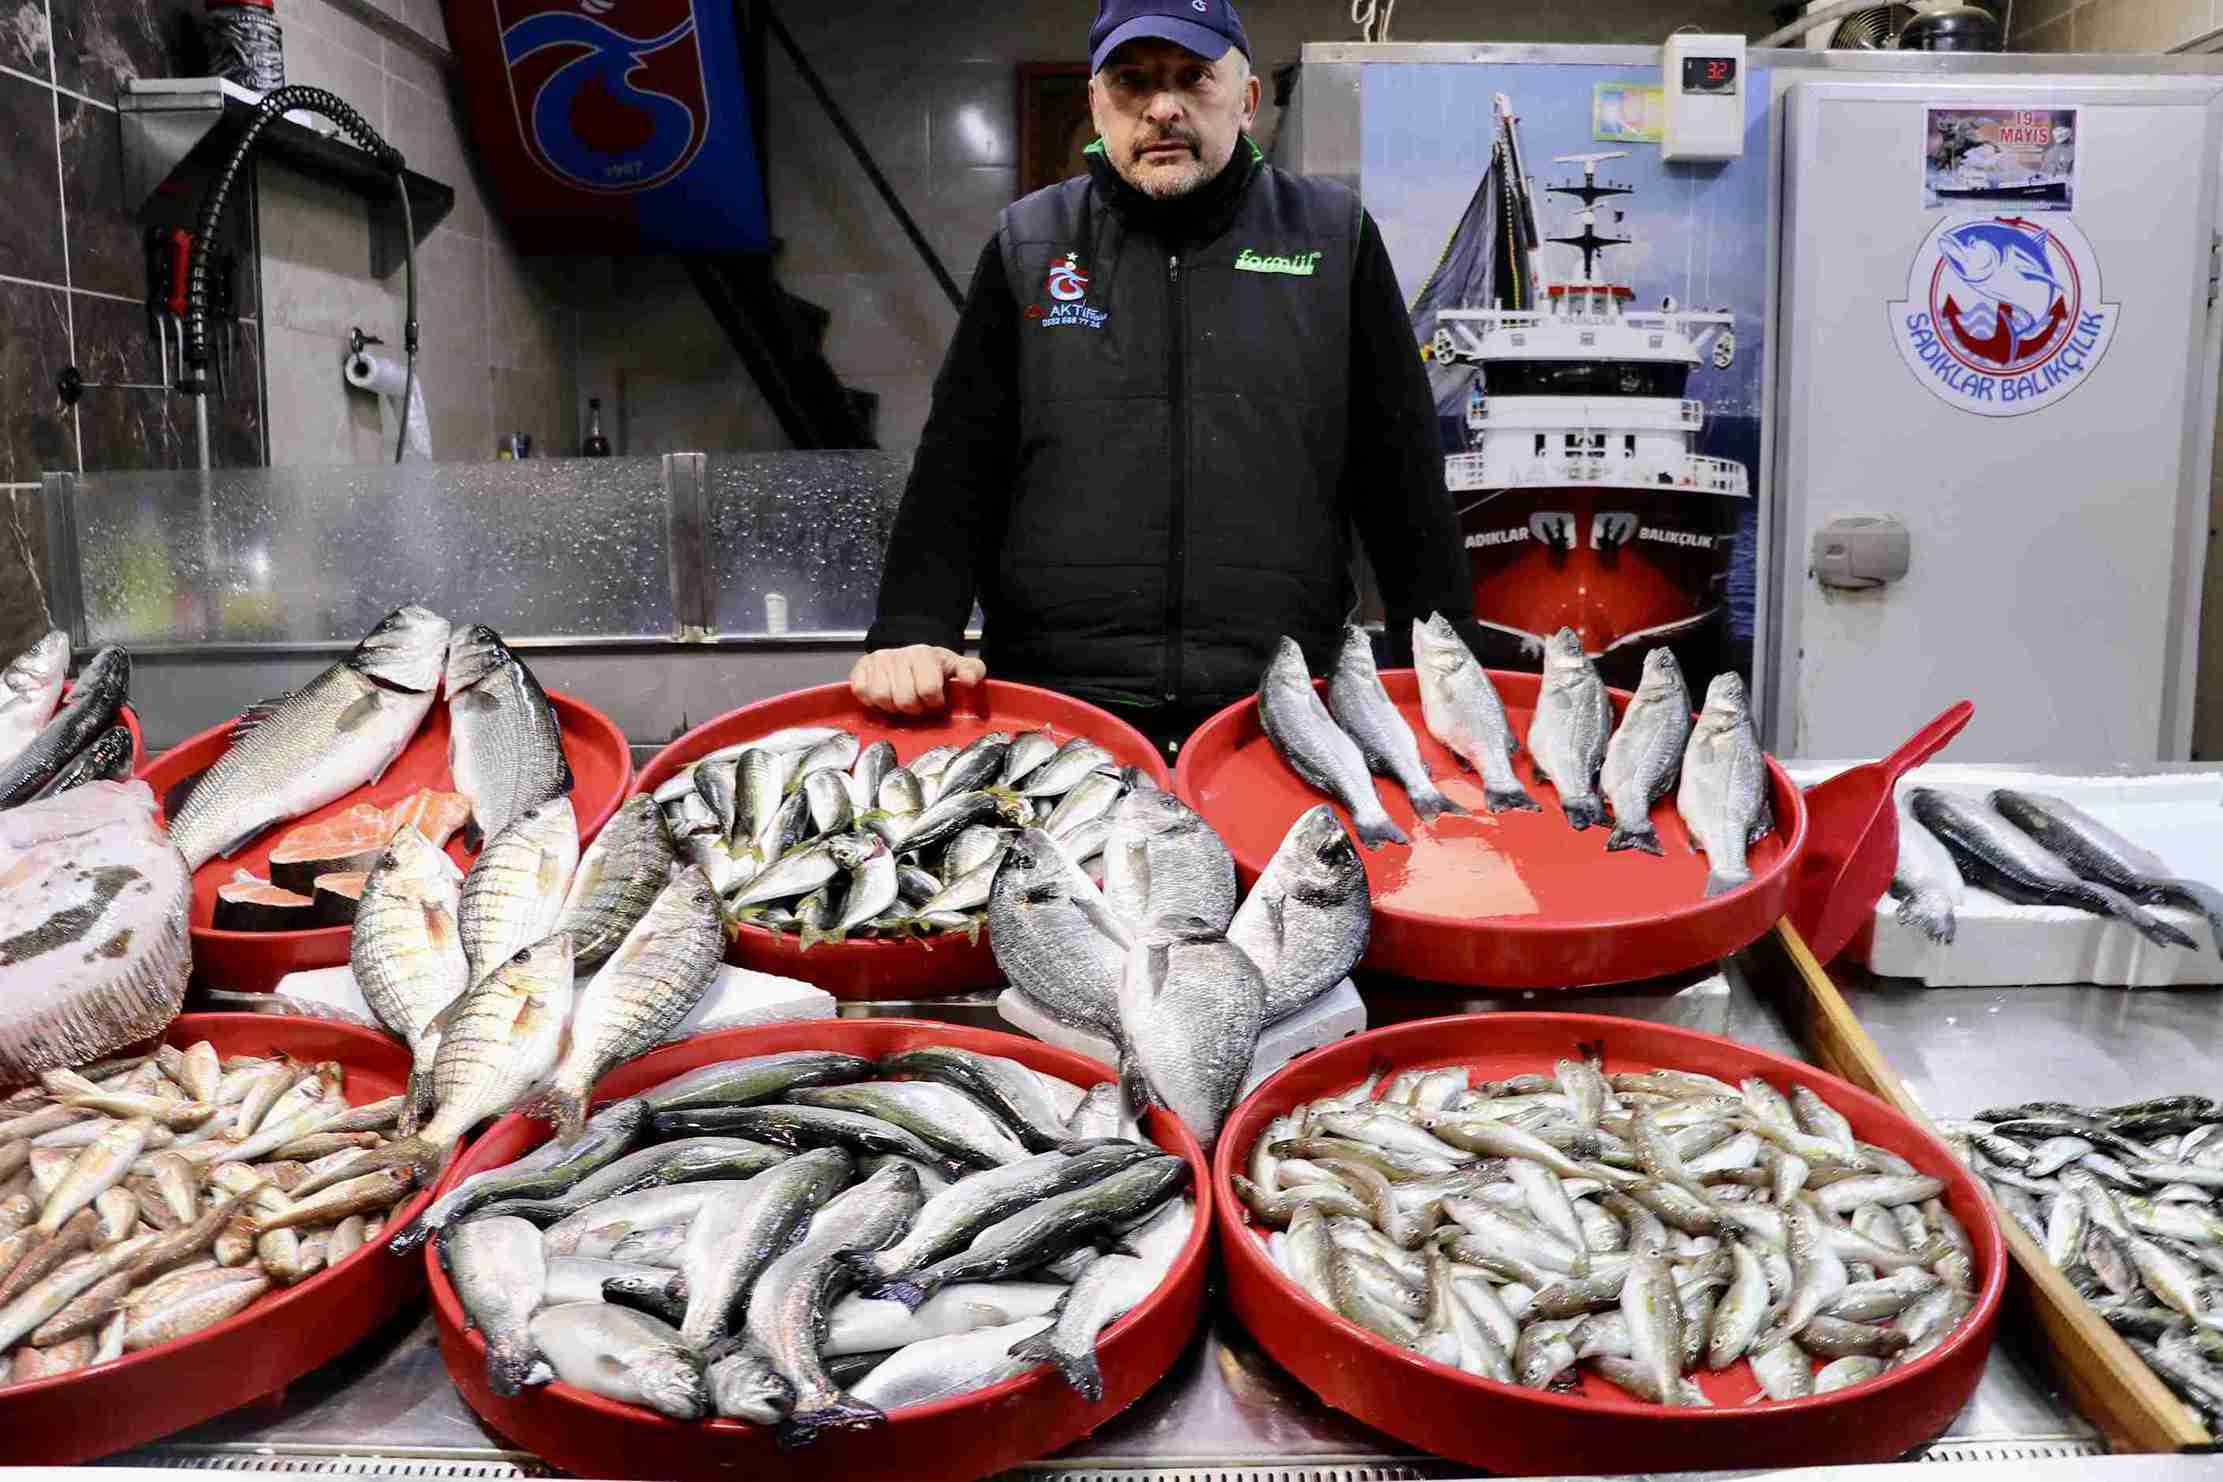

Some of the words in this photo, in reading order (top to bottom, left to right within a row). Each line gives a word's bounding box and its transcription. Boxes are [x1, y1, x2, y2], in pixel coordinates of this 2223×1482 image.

[2016, 111, 2033, 126] 19
[2000, 127, 2049, 144] MAYIS
[1906, 312, 1994, 402] SADIKLAR
[2001, 310, 2104, 402] BALIKÇILIK
[1464, 526, 1529, 549] ADIKLAR
